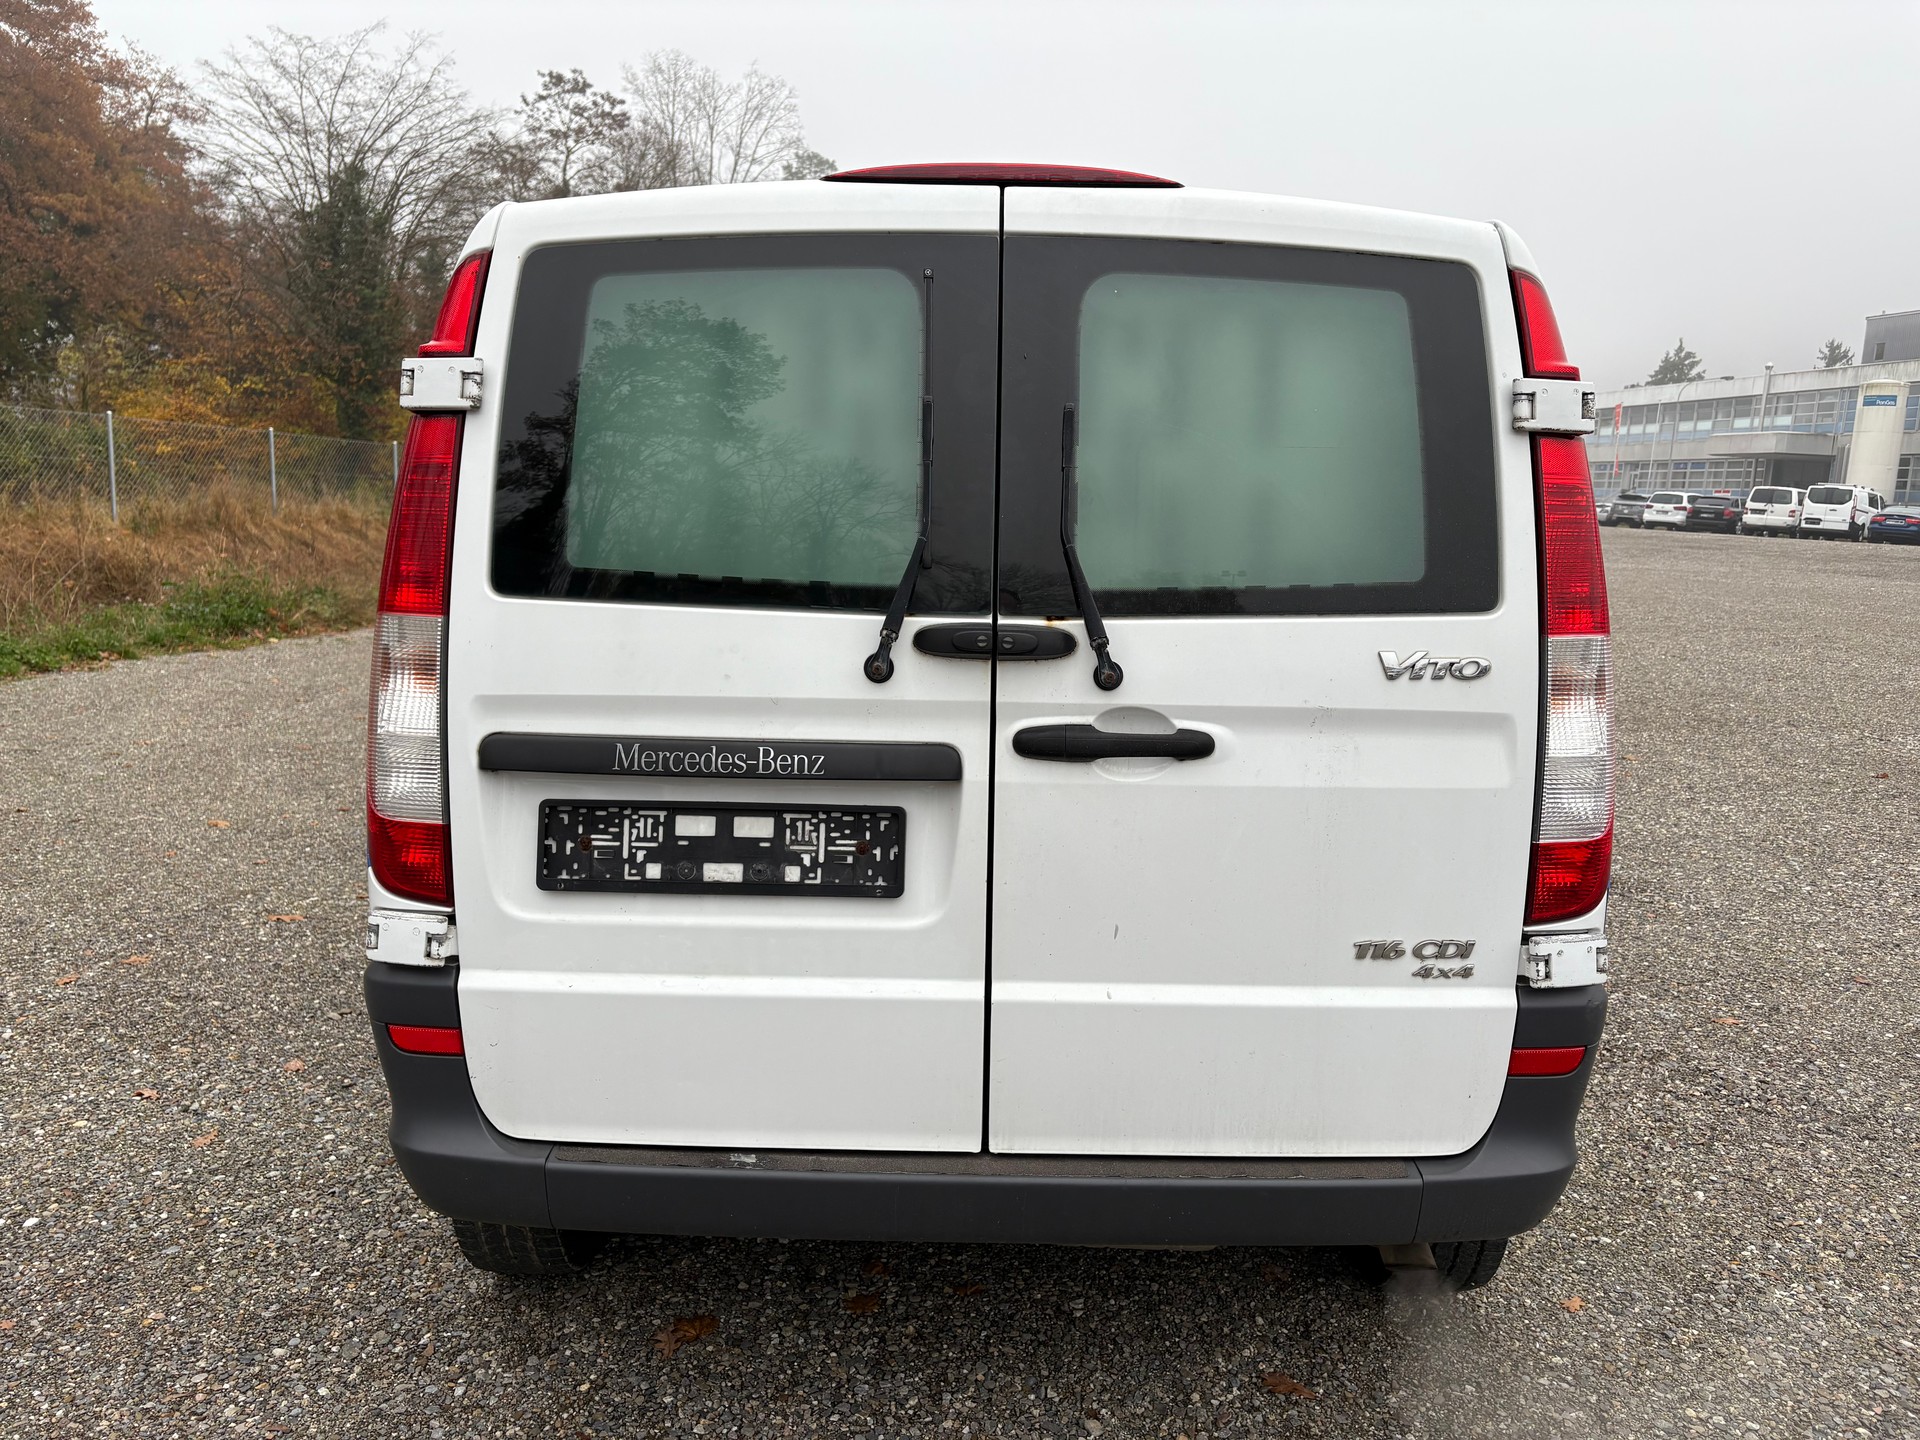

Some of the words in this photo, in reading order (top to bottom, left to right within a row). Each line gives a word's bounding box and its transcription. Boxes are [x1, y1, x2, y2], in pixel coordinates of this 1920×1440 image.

[612, 743, 825, 775] Mercedes-Benz
[1353, 940, 1406, 960] 116
[1412, 939, 1476, 960] CDI
[1411, 963, 1475, 979] 4x4
